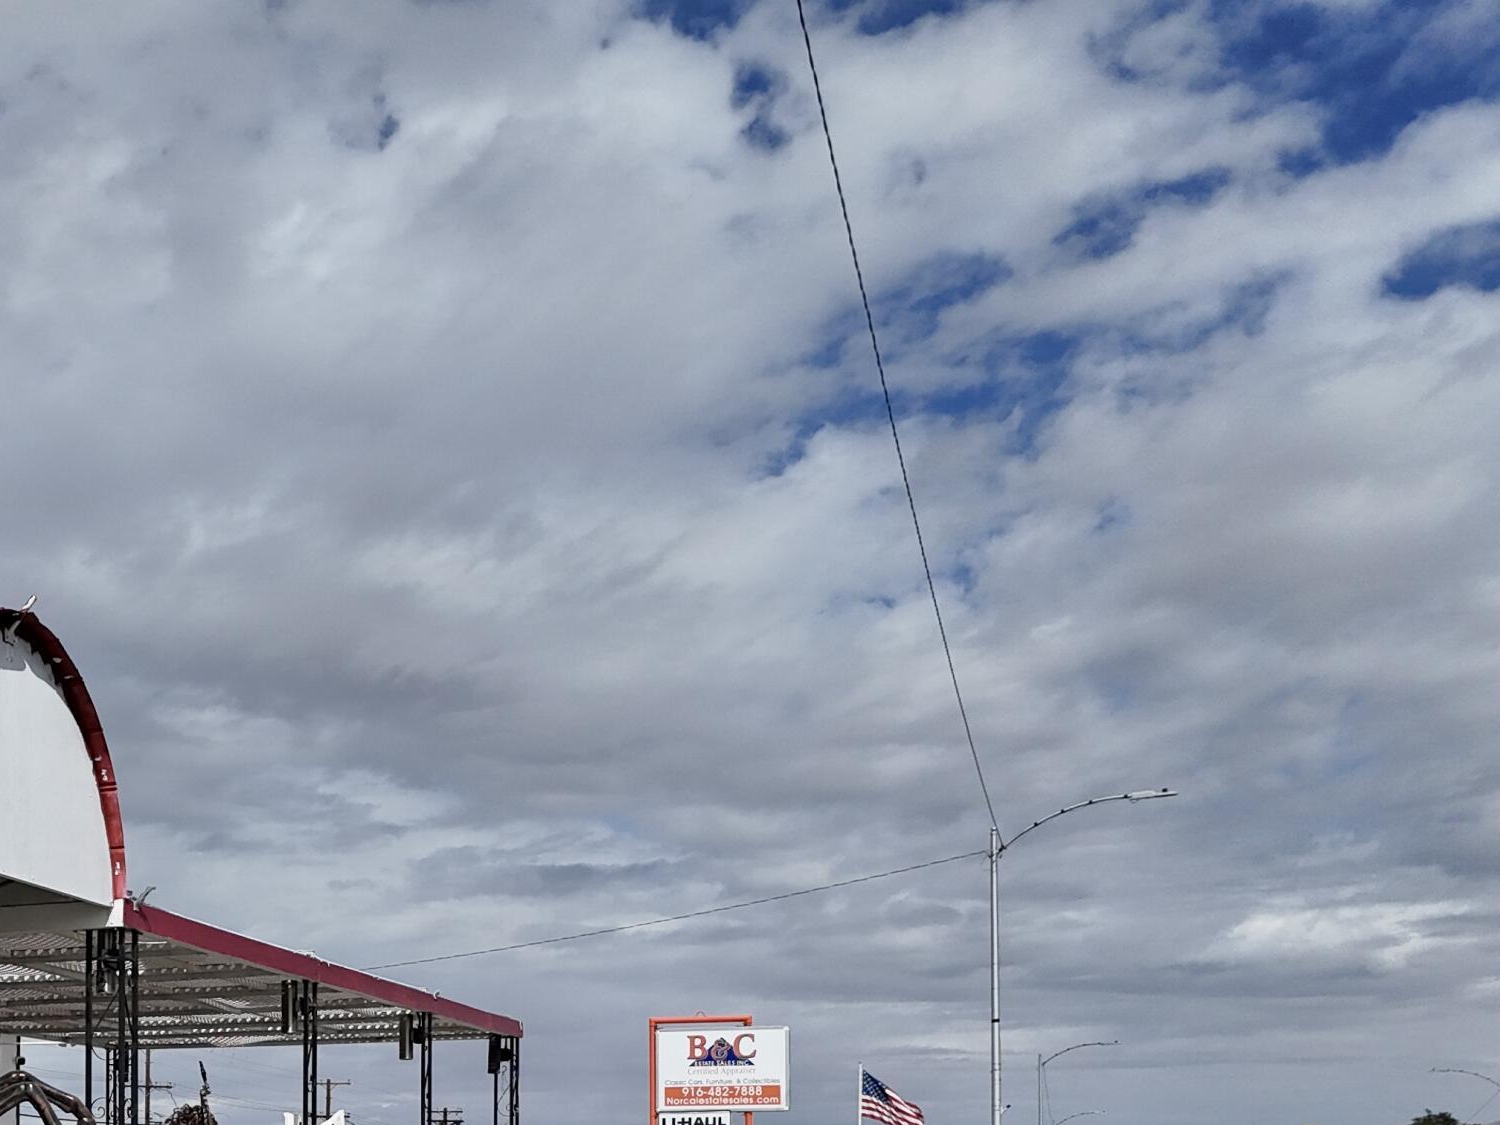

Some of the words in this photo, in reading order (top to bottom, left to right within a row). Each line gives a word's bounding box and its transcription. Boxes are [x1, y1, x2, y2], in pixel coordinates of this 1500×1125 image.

[687, 1067, 718, 1076] Certified
[681, 1086, 763, 1097] 916-482-7888
[666, 1096, 780, 1105] Norcalestatesales.com
